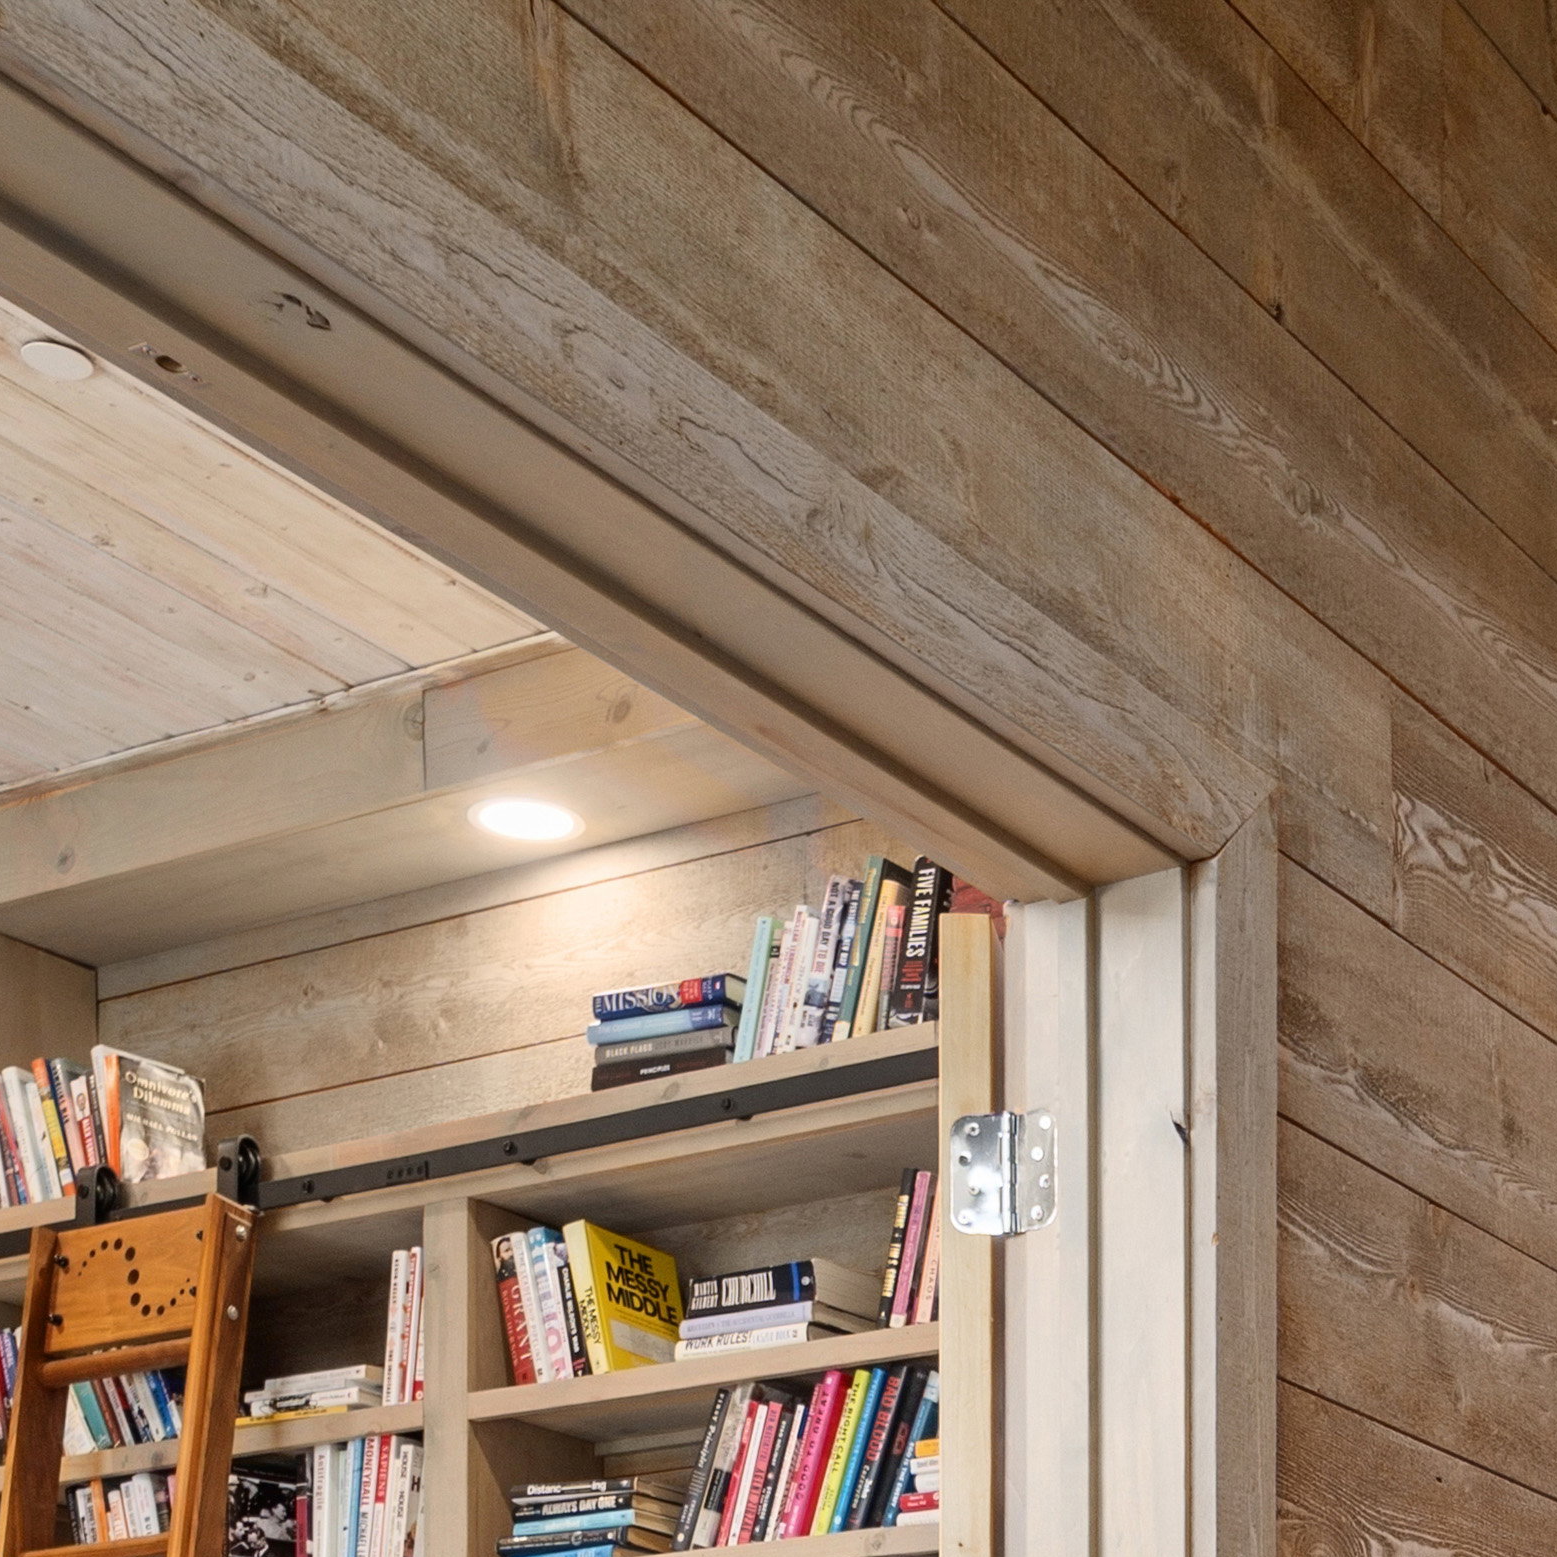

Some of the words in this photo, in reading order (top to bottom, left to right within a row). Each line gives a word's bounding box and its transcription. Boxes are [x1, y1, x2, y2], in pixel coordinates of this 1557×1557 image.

[829, 882, 840, 898] NOT
[915, 868, 936, 897] FIVE
[823, 908, 836, 929] GOOD
[906, 899, 933, 957] FAMILIES
[818, 949, 828, 959] TO
[822, 931, 833, 945] DAY
[816, 961, 827, 974] DIE
[125, 1070, 198, 1104] Omnivore's
[134, 1086, 192, 1116] Dilemma
[614, 1244, 653, 1276] THE
[605, 1261, 670, 1298] MESSY
[722, 1271, 776, 1307] CHURCHILL
[926, 1258, 938, 1302] CHAOS
[562, 1267, 572, 1299] CHARLIE
[572, 1336, 580, 1353] WAR
[579, 1299, 591, 1339] MIDDLE
[584, 1286, 594, 1310] THE
[590, 1312, 601, 1344] MESSY
[606, 1282, 680, 1328] MIDDLE
[511, 1284, 532, 1360] GRANT
[710, 1393, 725, 1421] FIRST
[849, 1383, 861, 1405] THE
[881, 1376, 901, 1407] BAD
[777, 1420, 787, 1437] RYAN
[839, 1407, 856, 1443] RIGHT
[866, 1411, 892, 1461] BLOOD
[697, 1424, 717, 1468] Principles
[770, 1439, 782, 1466] HOLIDAY
[794, 1464, 810, 1500] GOOD
[806, 1440, 816, 1456] TO
[812, 1390, 829, 1434] GREAT
[832, 1445, 845, 1473] CALL
[361, 1438, 375, 1506] MONEYBALL
[377, 1445, 389, 1498] SAPIENS
[400, 1451, 409, 1478] HOUSE
[397, 1490, 406, 1518] HOUSE
[542, 1500, 578, 1516] ALWAYS
[579, 1500, 598, 1512] DAY
[598, 1496, 617, 1508] ONE
[358, 1511, 369, 1547] MICHAEL
